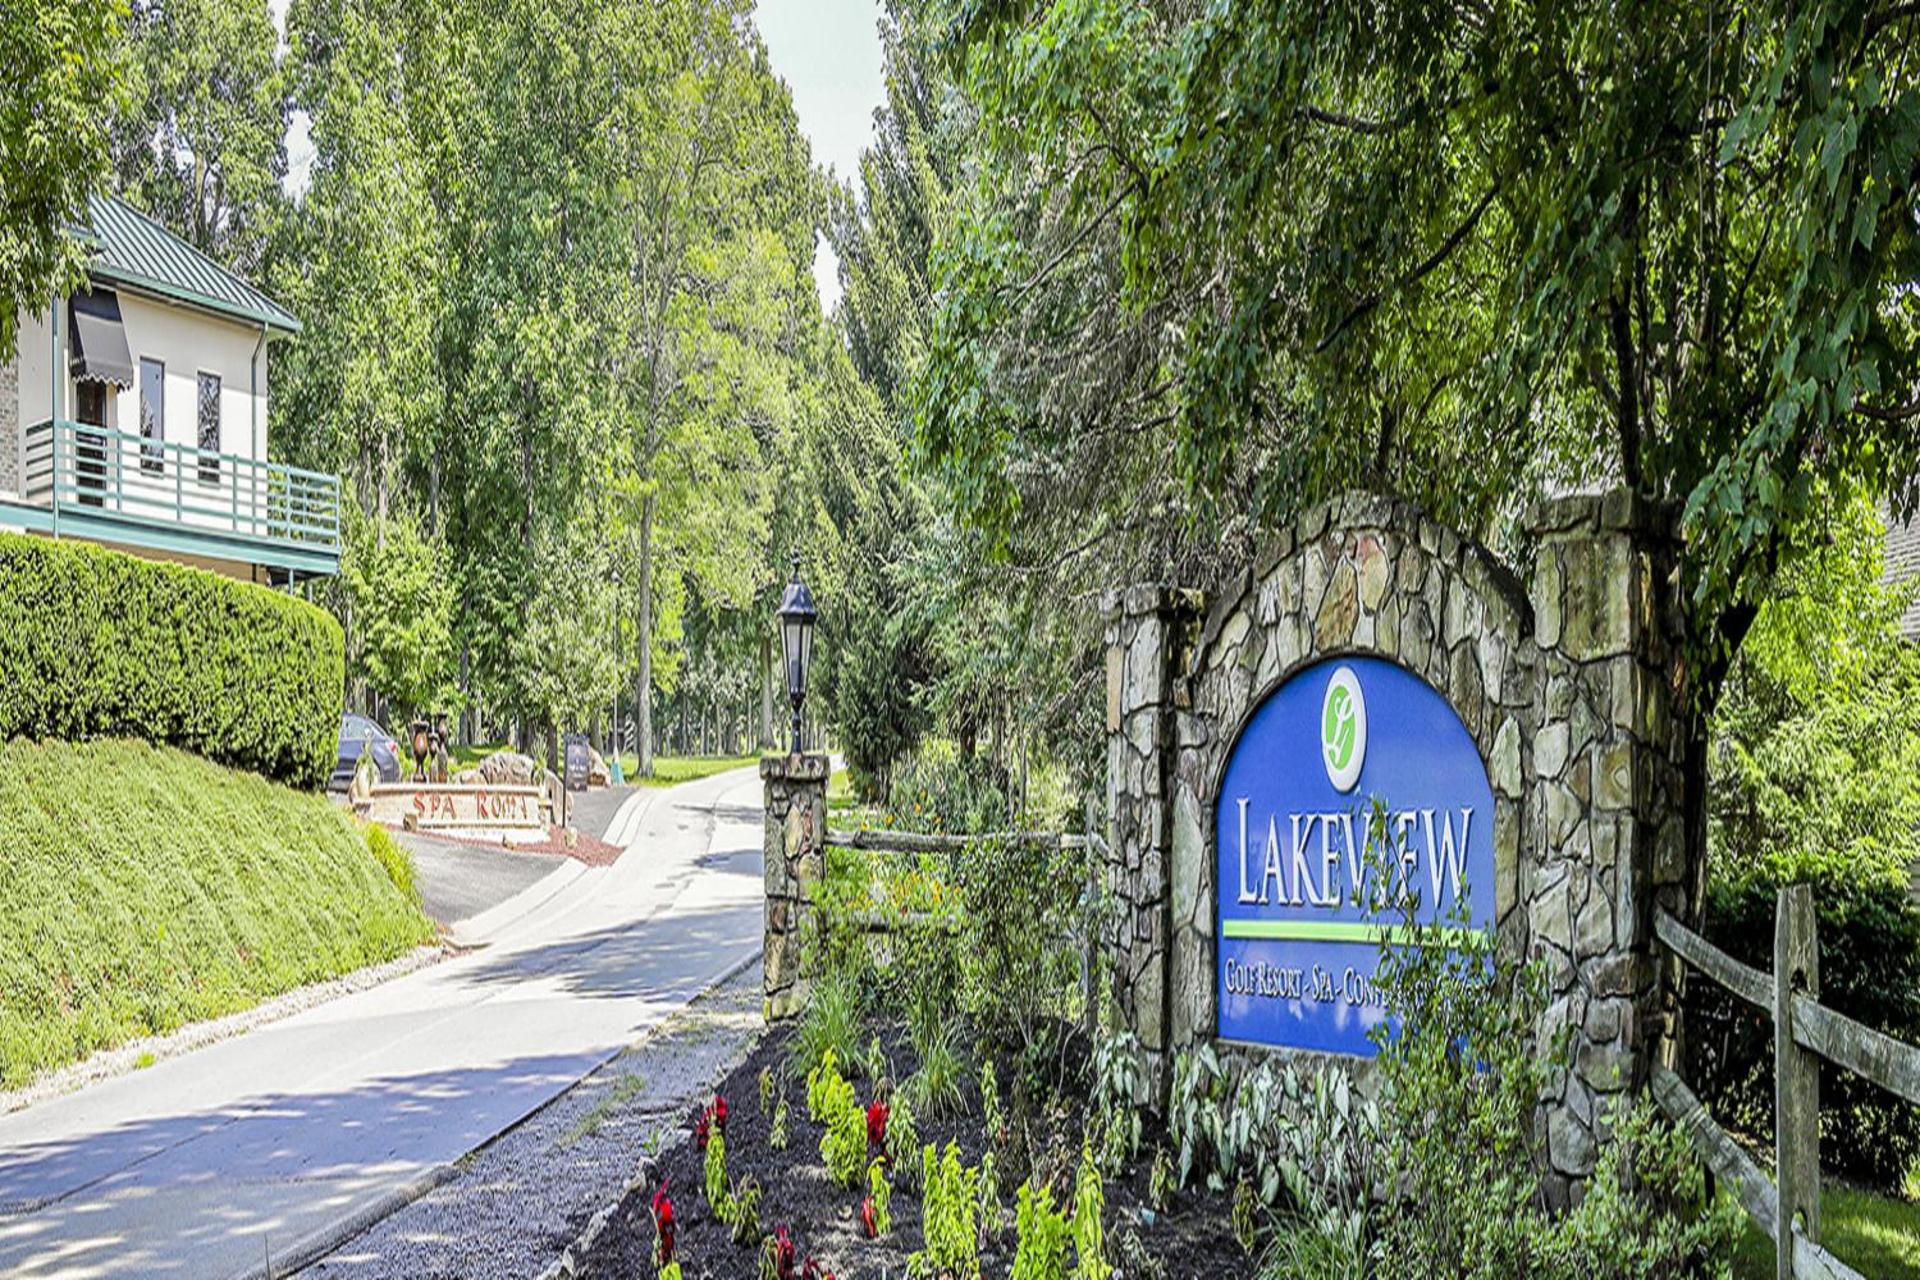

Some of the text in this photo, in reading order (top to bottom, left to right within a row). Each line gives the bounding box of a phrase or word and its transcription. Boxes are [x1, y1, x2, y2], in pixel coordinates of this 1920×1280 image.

[413, 790, 457, 819] SPA
[1237, 797, 1473, 909] LAKEVIEW
[1224, 957, 1257, 994] GOLF
[1258, 961, 1303, 999] RESORT
[1312, 963, 1335, 1002] SPA
